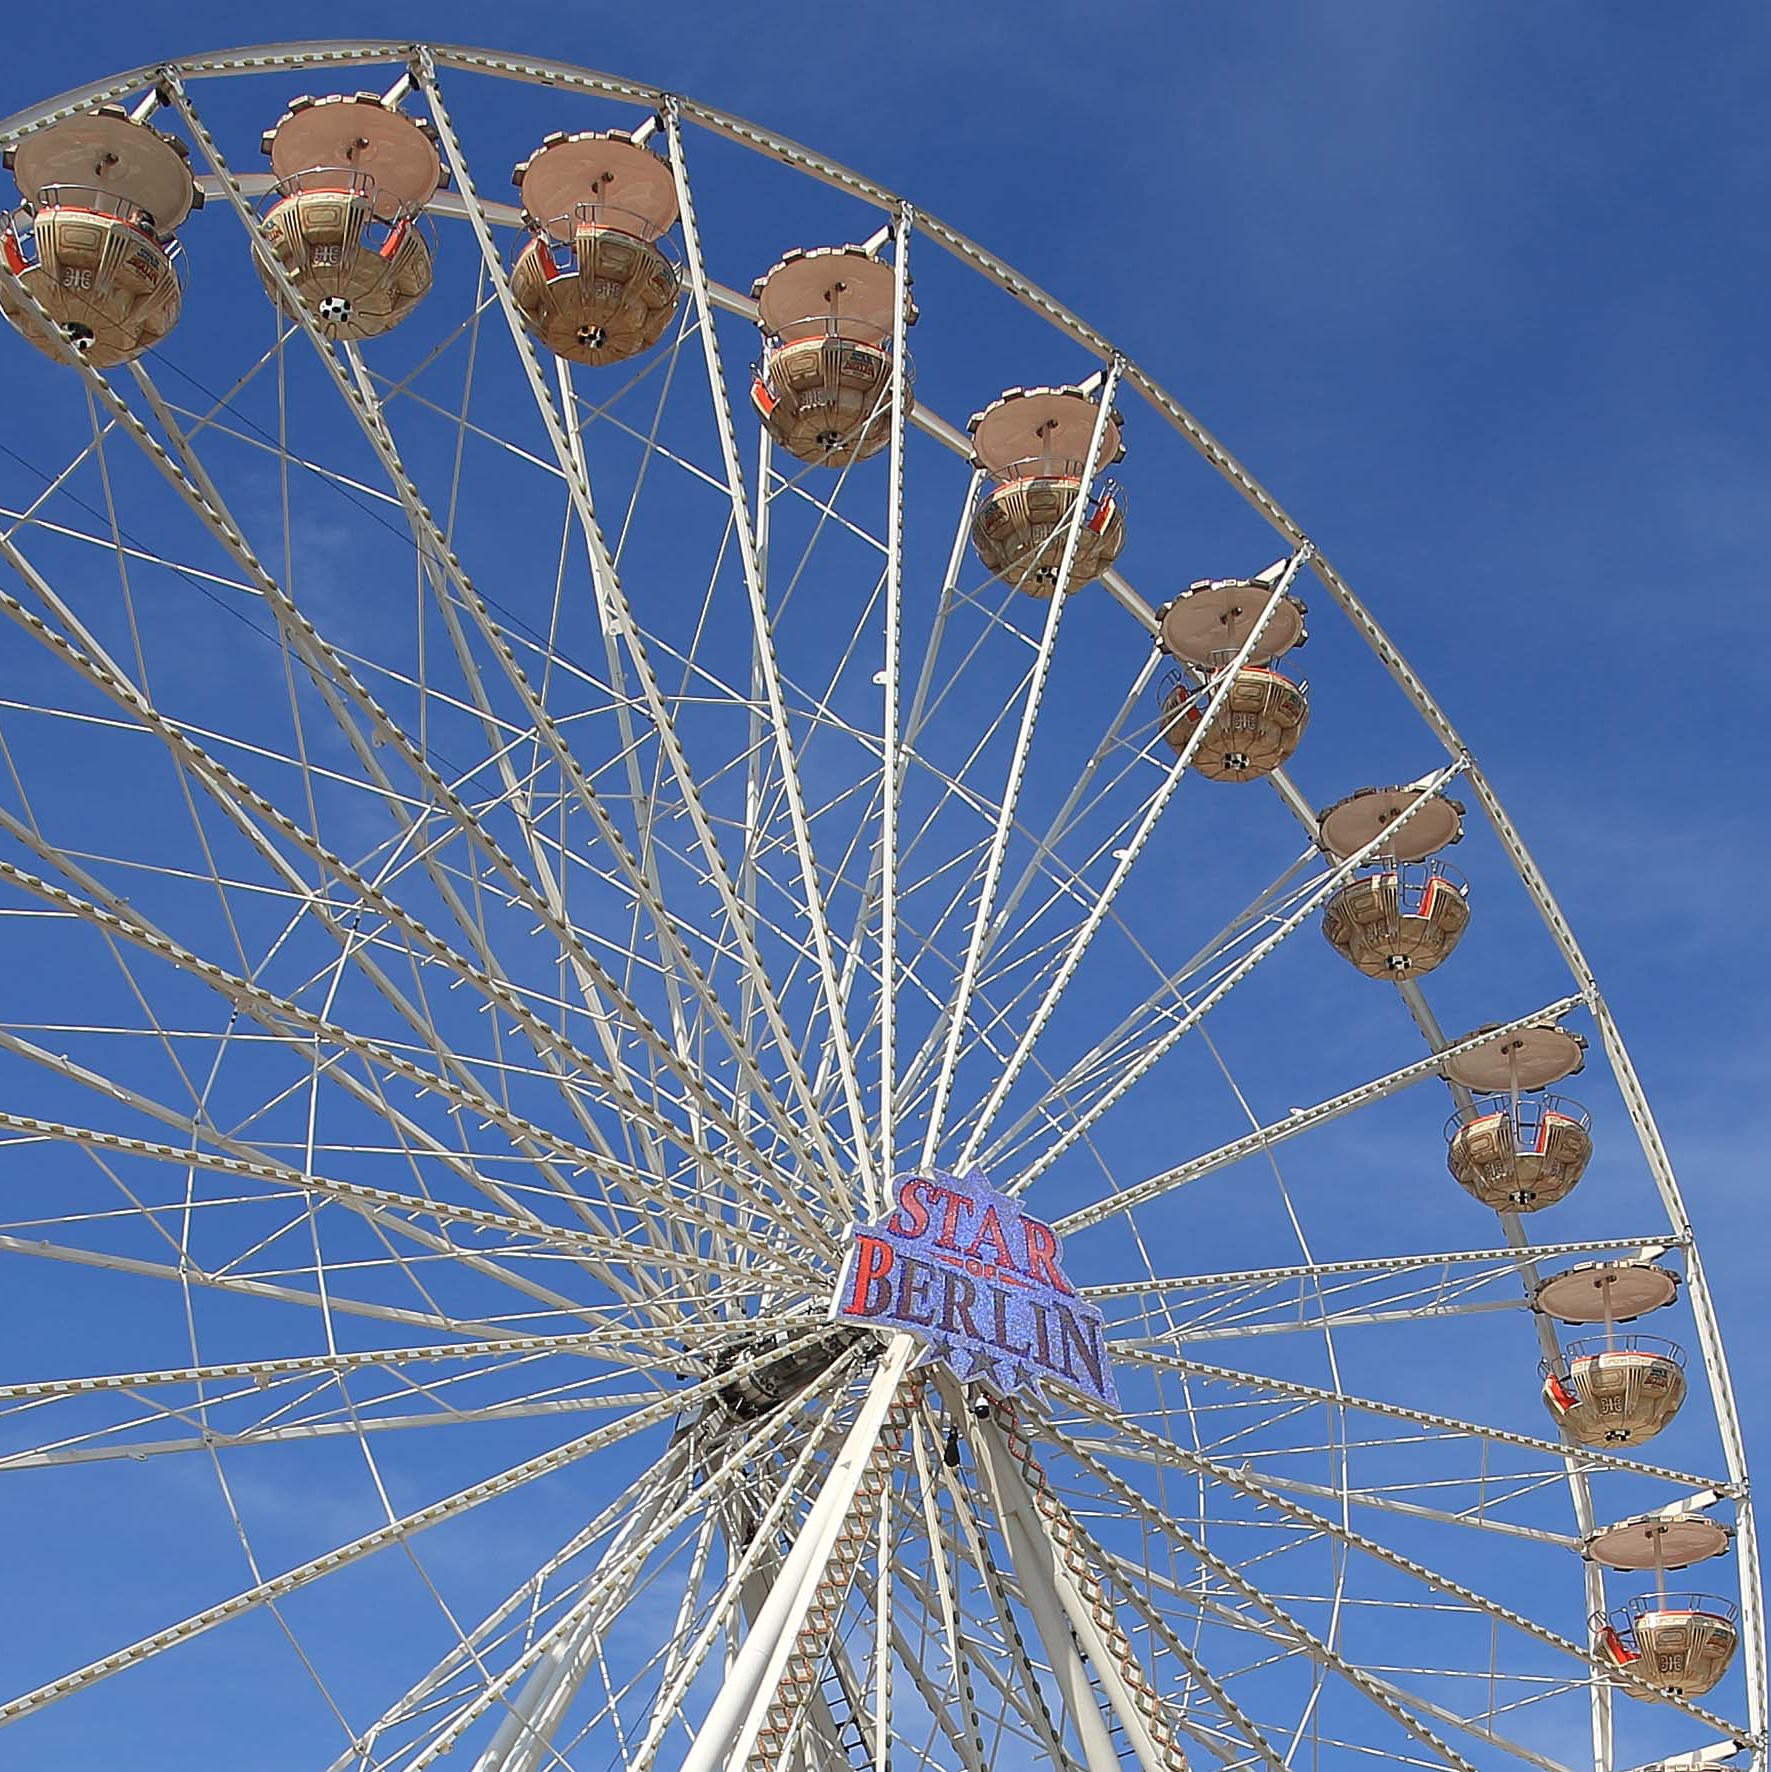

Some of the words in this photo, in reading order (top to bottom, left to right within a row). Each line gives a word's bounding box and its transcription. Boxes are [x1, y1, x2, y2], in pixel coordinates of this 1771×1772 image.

[888, 1178, 1075, 1297] STAR
[966, 1259, 997, 1280] OF
[843, 1234, 1105, 1396] BERLIN
